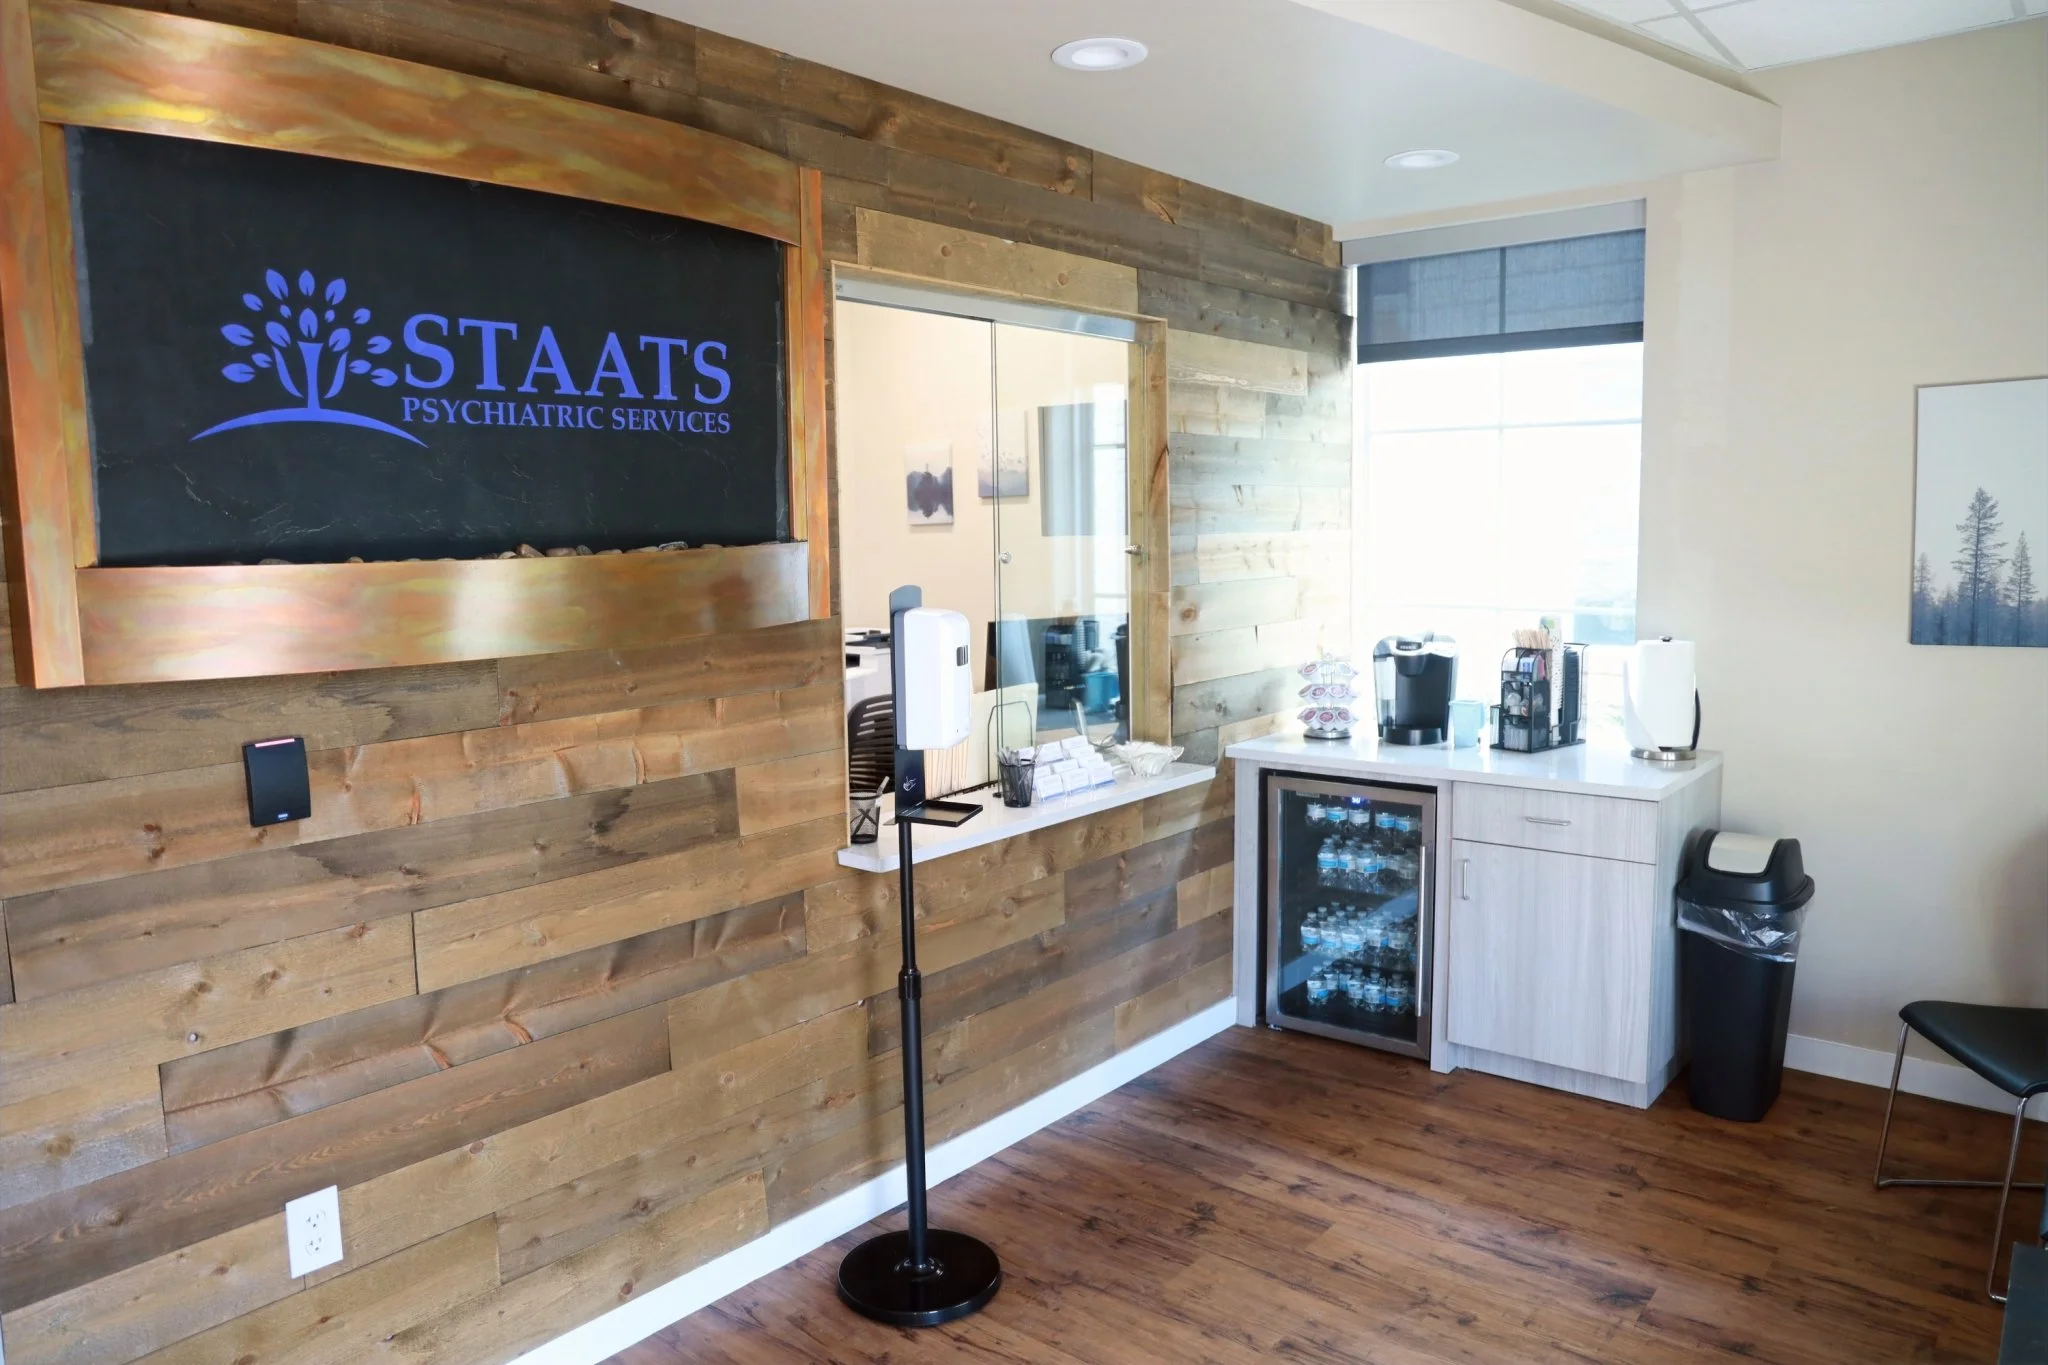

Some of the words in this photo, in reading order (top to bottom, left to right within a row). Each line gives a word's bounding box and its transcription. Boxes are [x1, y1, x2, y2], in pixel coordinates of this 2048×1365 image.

[402, 312, 732, 405] STAATS
[401, 396, 604, 430] PSYCHIATRIC
[611, 407, 731, 434] SERVICES
